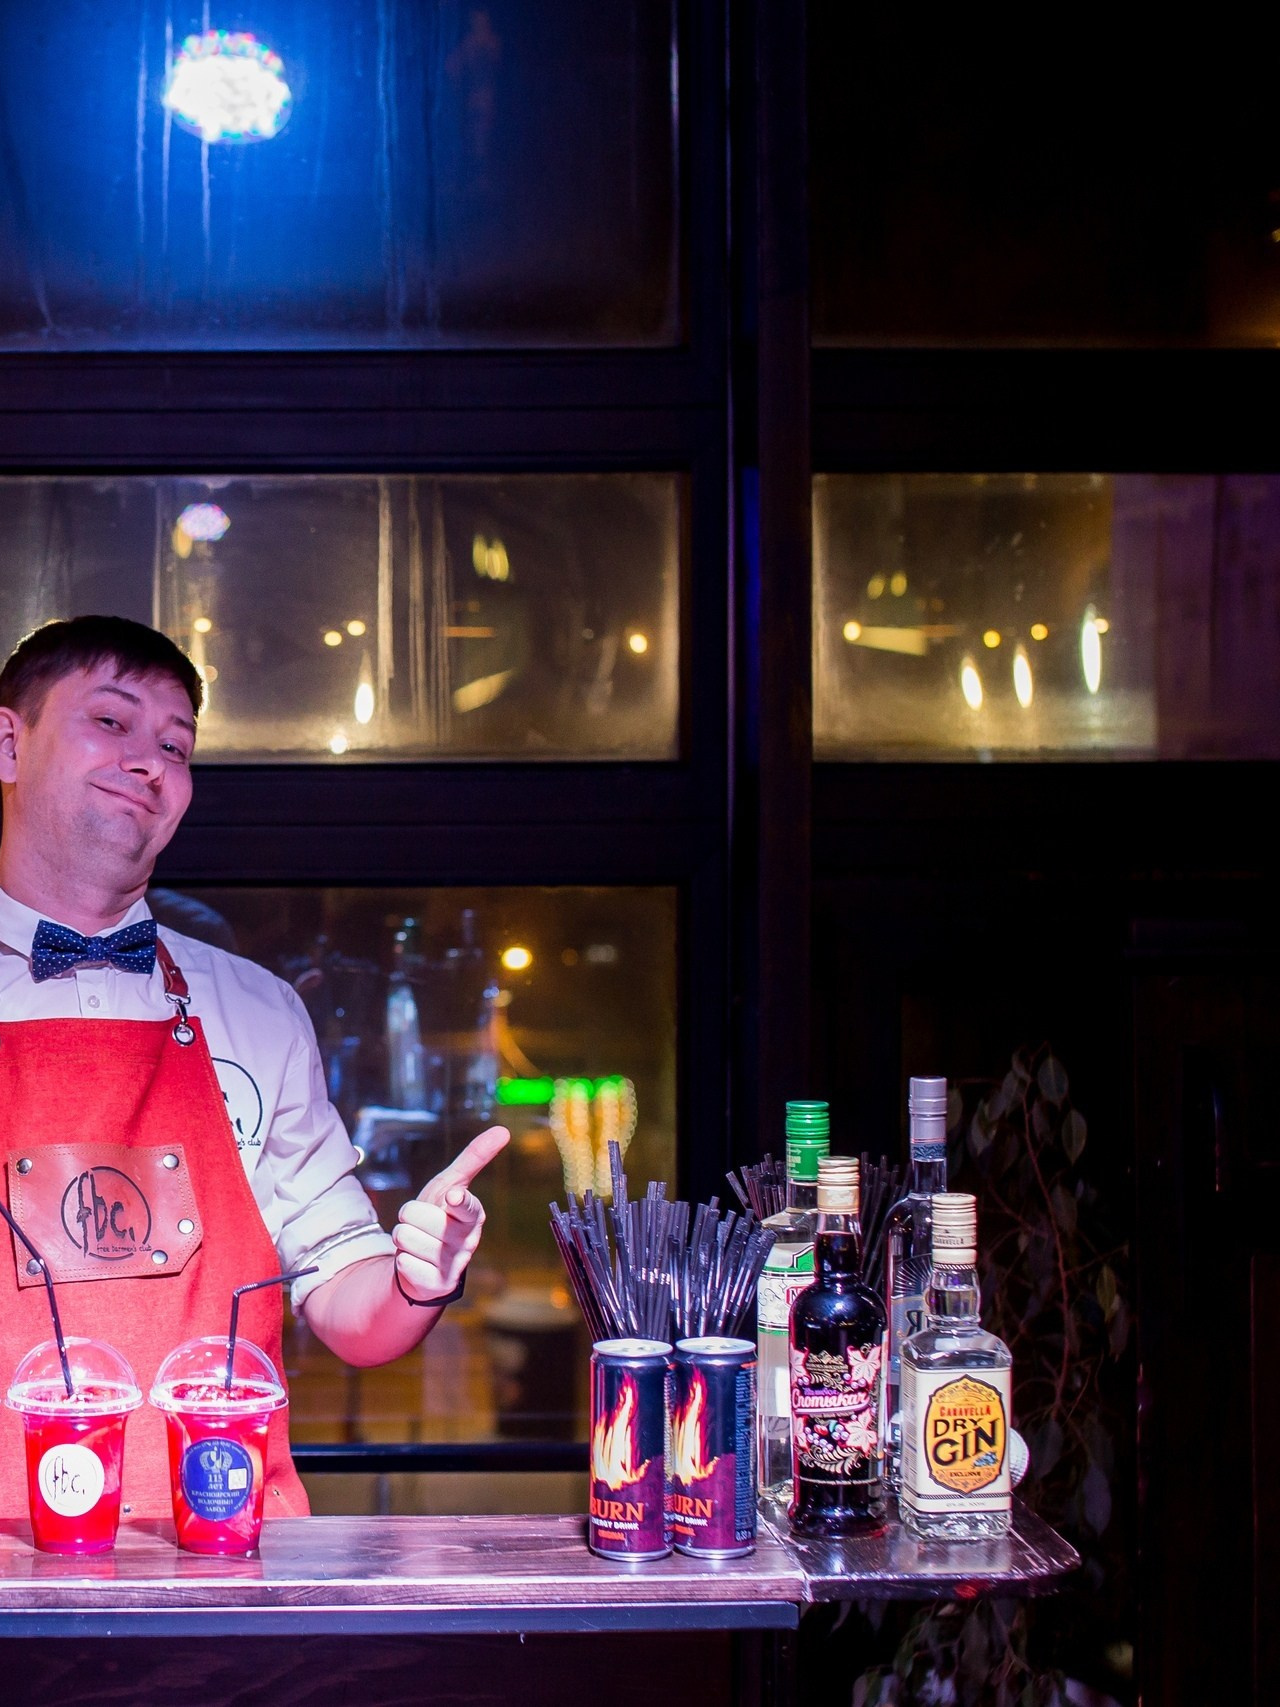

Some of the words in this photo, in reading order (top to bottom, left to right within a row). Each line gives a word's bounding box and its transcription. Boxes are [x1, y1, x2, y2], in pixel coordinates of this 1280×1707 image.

[939, 1405, 992, 1417] CARAVELLA
[933, 1417, 984, 1438] DRY
[932, 1418, 1000, 1468] GIN
[207, 1473, 223, 1482] 115
[590, 1497, 645, 1522] BURN
[673, 1493, 714, 1519] URN
[613, 1521, 640, 1530] DRINK
